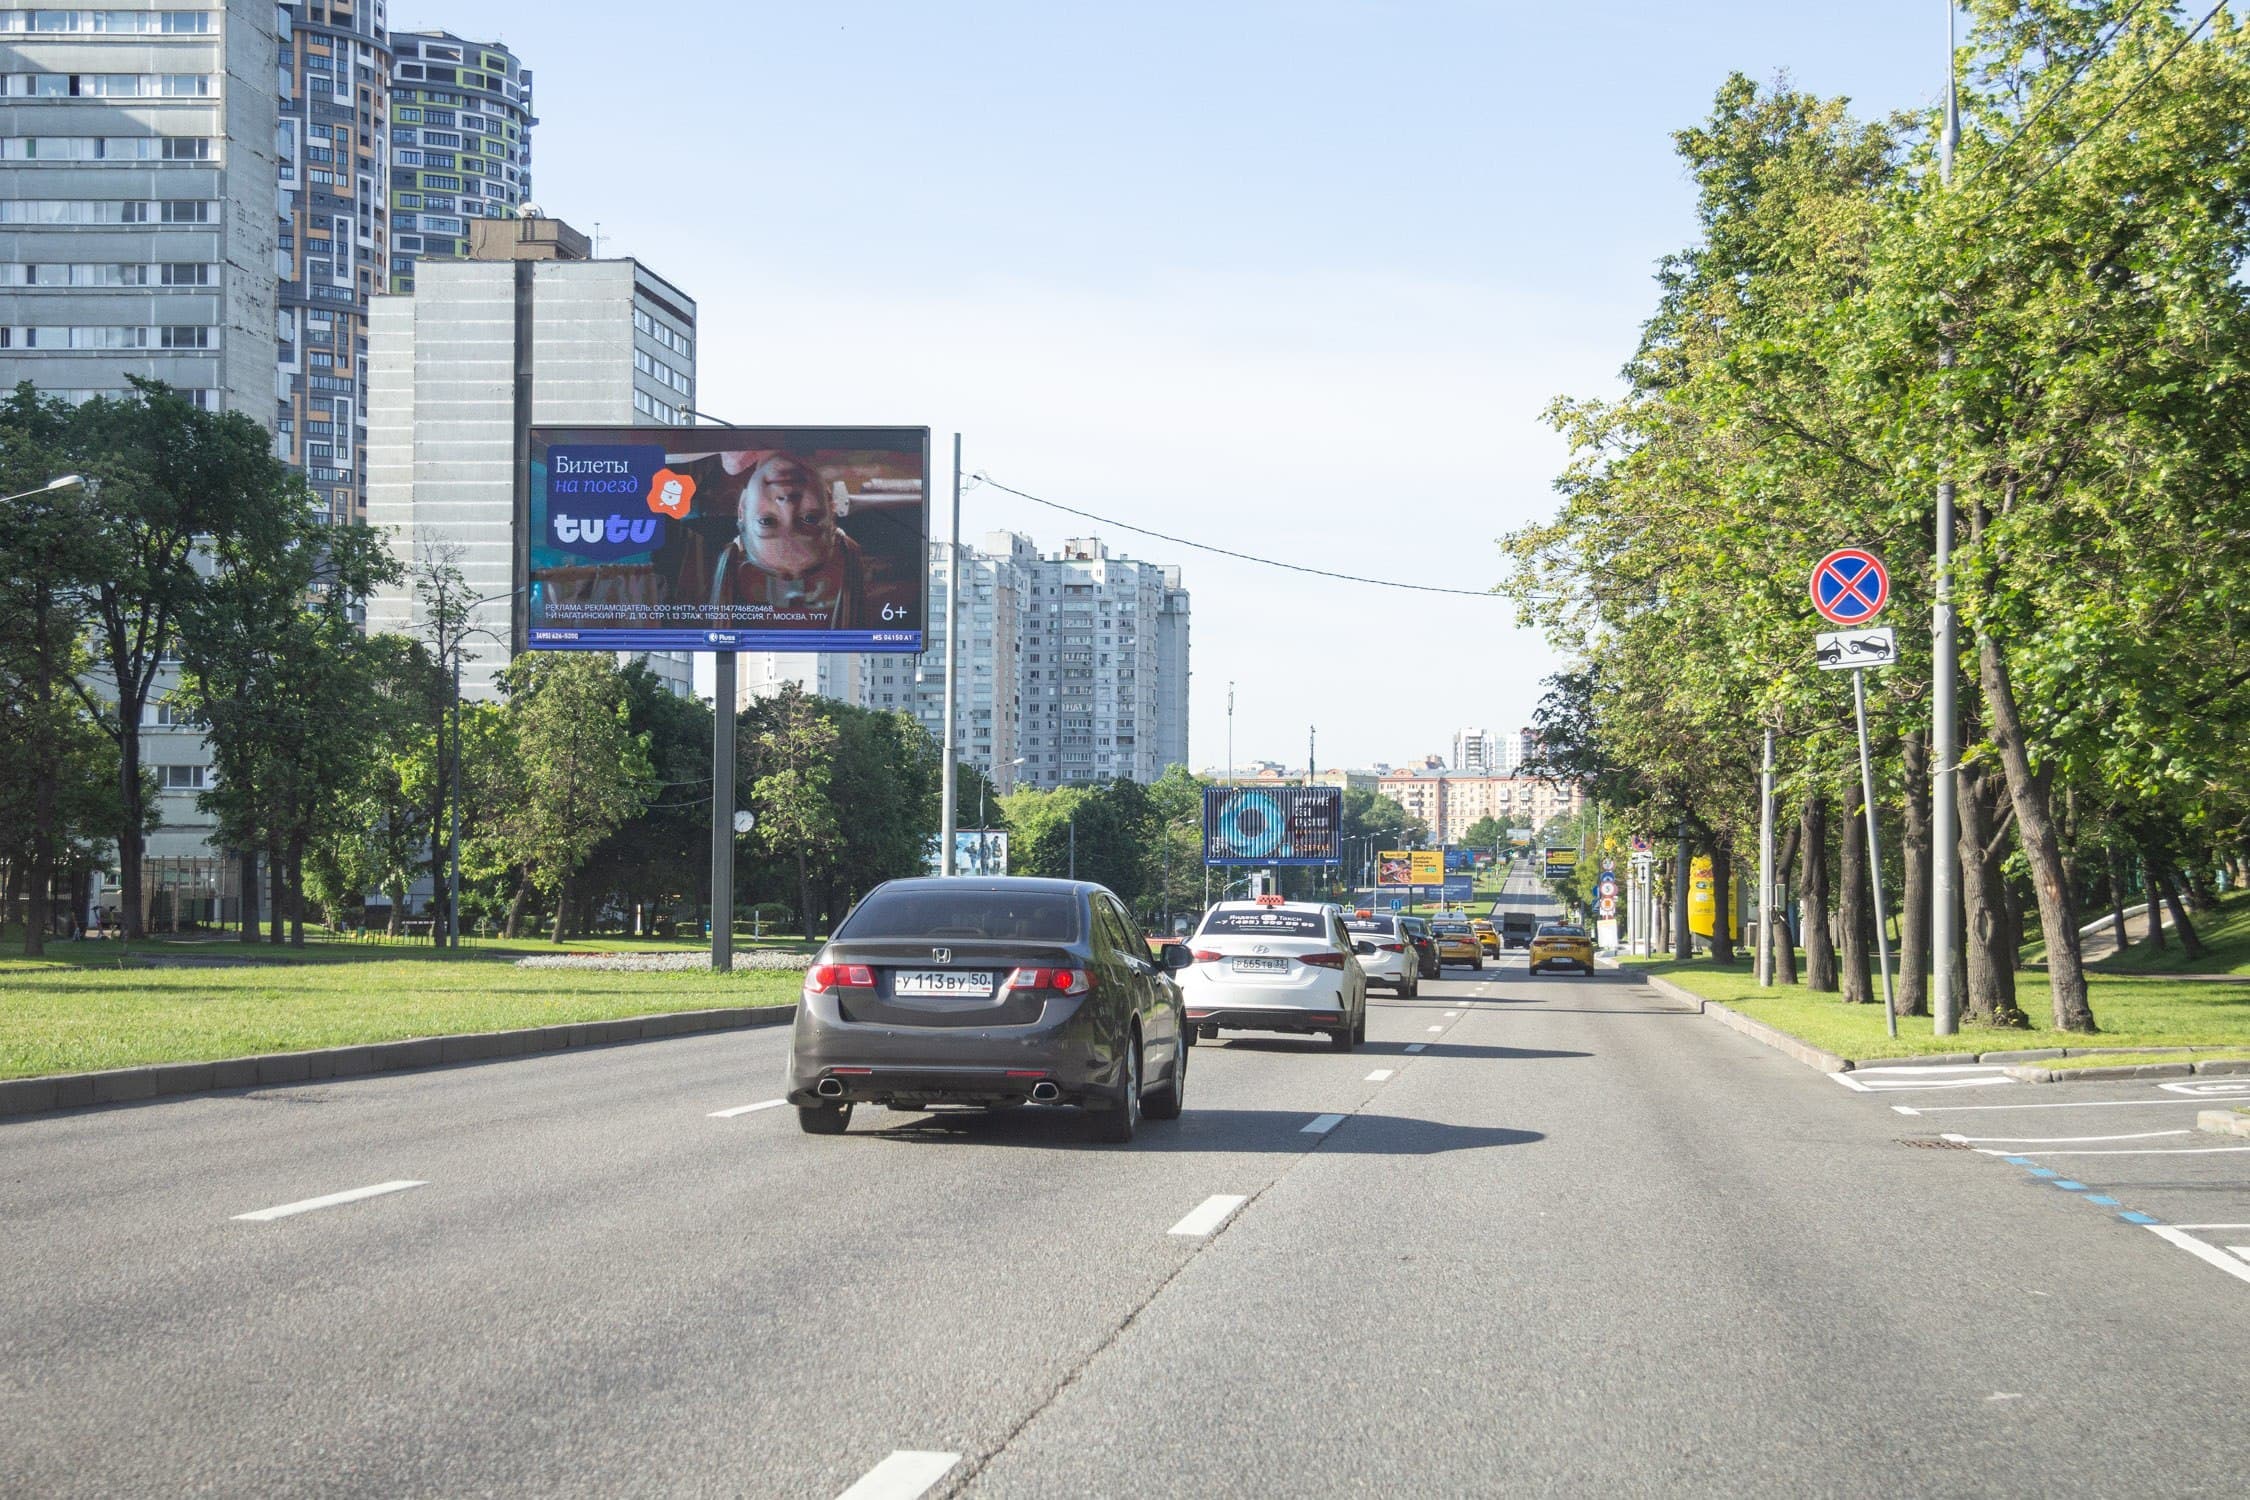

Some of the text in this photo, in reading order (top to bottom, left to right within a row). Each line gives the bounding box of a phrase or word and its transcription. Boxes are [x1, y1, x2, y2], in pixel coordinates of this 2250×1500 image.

[555, 455, 629, 474] Билеты
[555, 475, 638, 493] на поезд
[553, 513, 657, 544] tutu
[558, 612, 614, 620] НАГАТИНСКИЙ
[881, 602, 908, 621] 6+
[970, 974, 987, 986] 50
